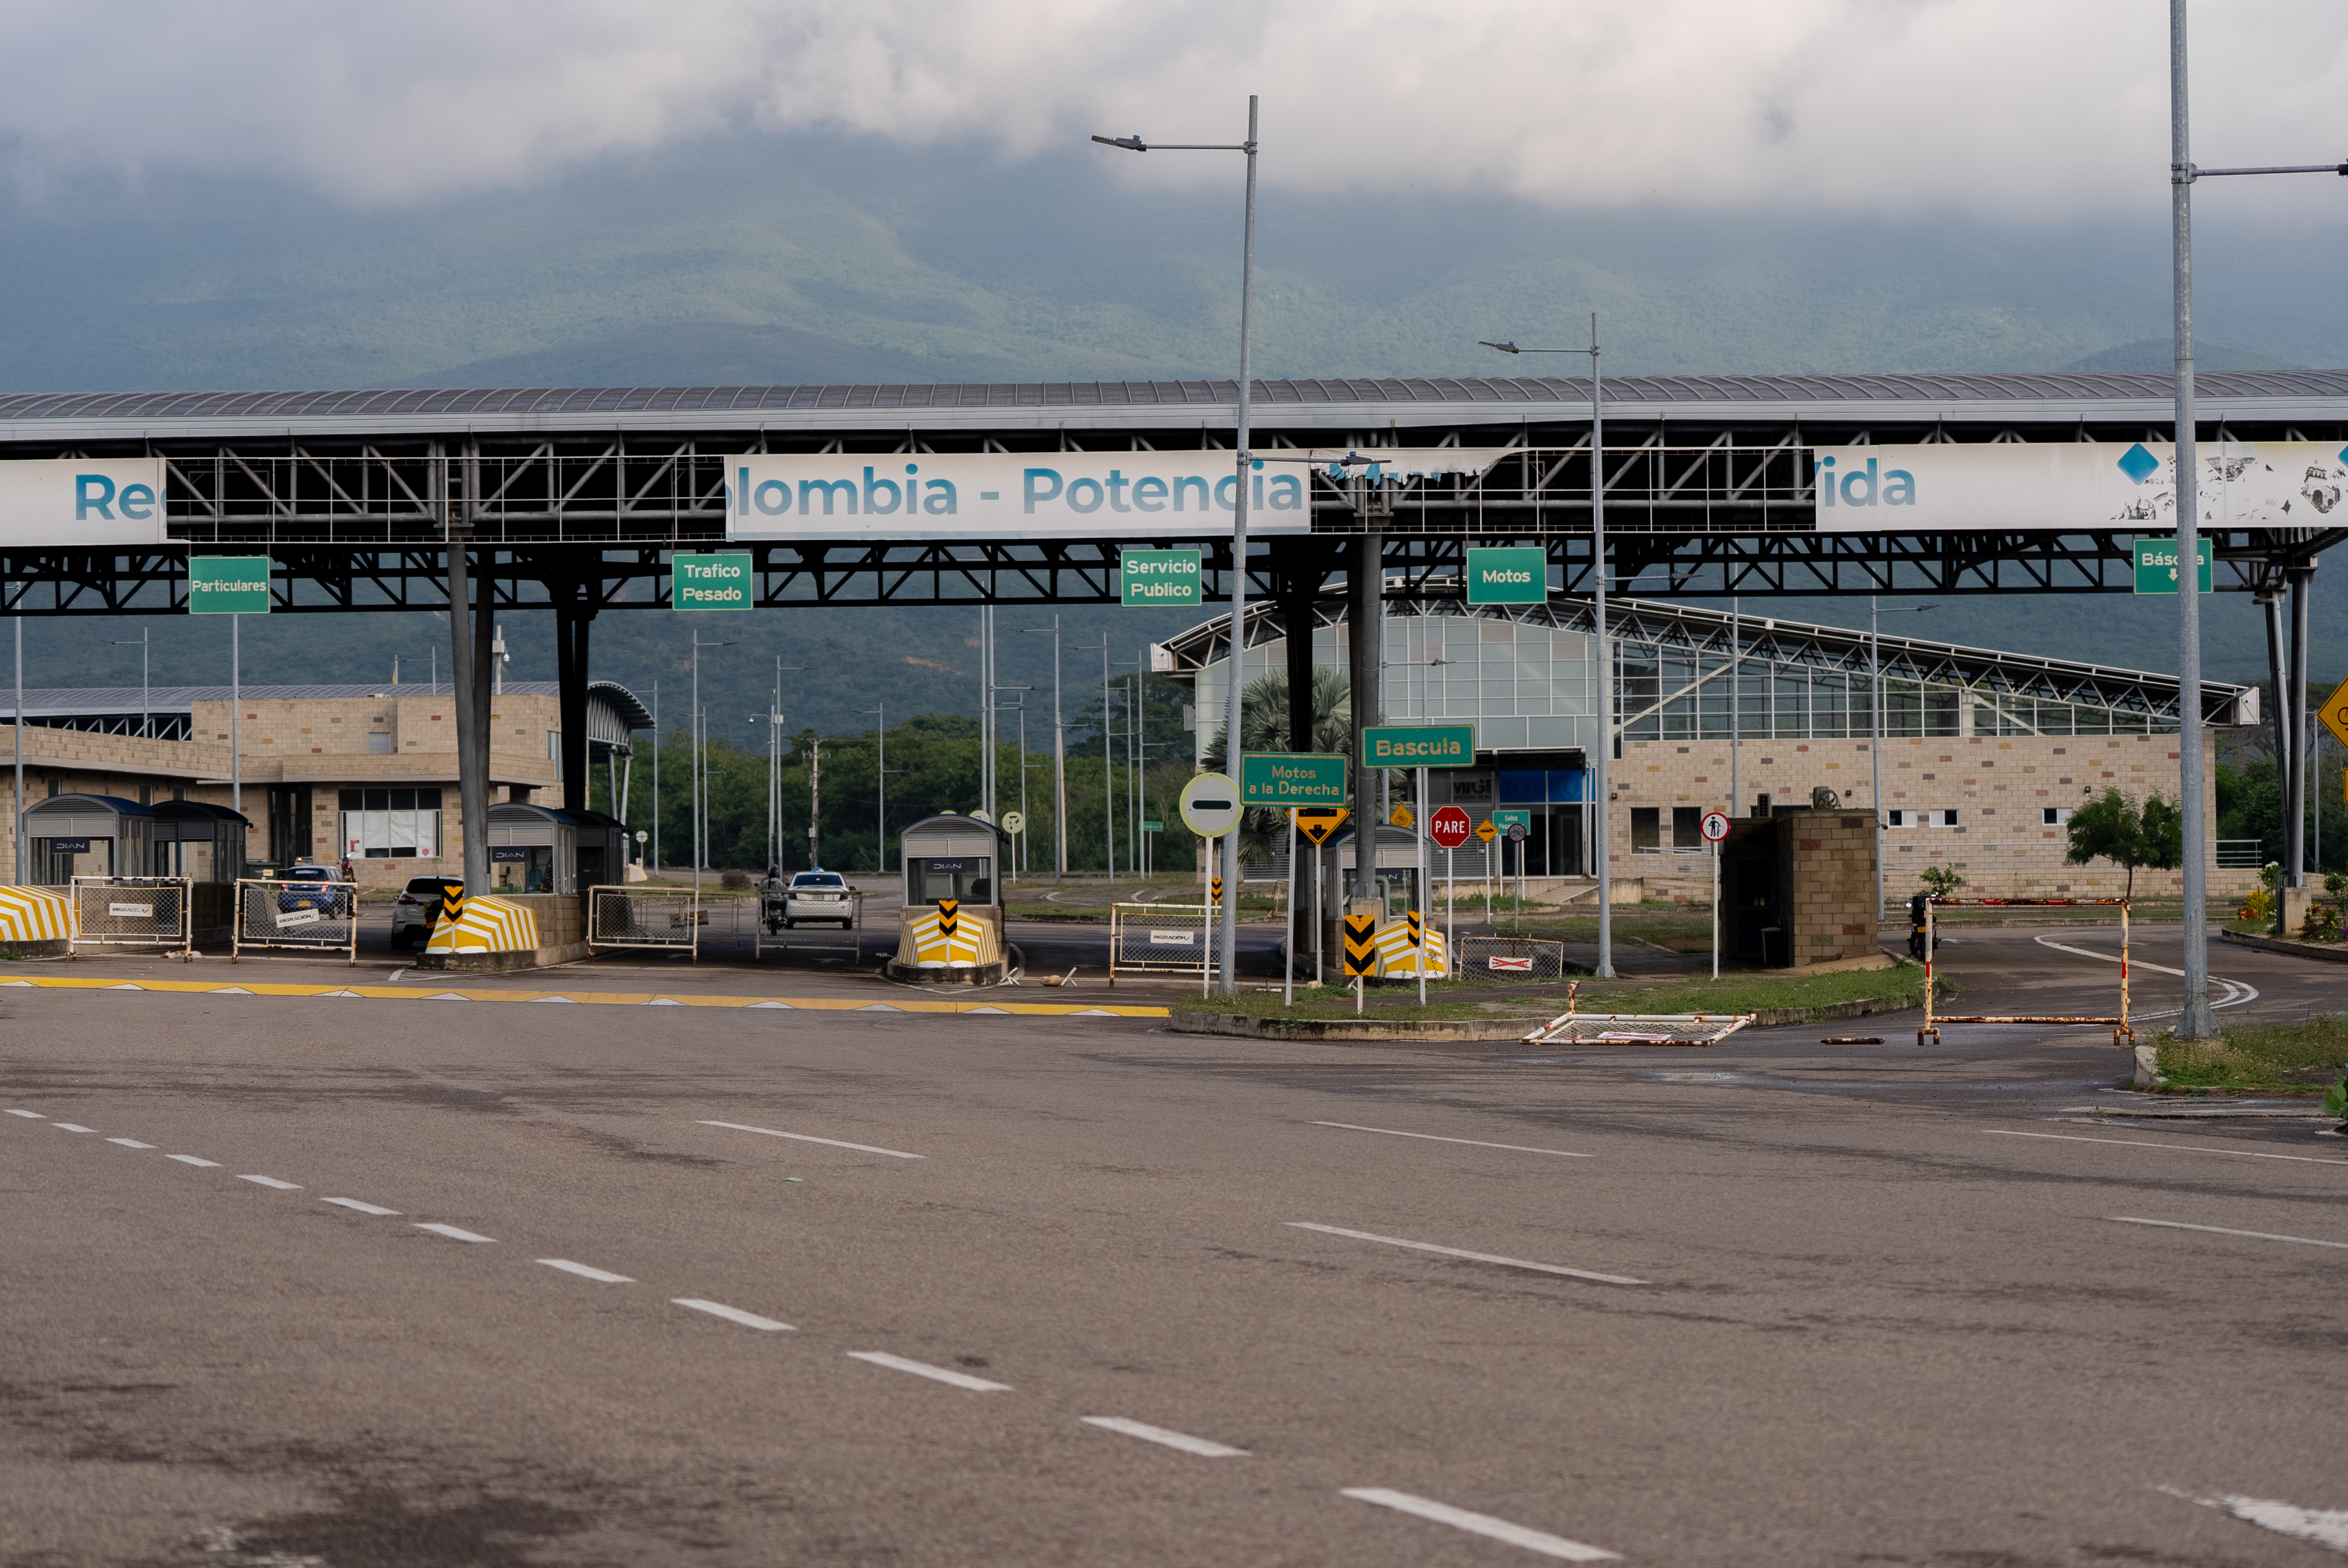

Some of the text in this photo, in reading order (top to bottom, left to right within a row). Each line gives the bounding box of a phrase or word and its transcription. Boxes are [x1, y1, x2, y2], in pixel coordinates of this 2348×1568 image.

[76, 474, 166, 528] Re
[1024, 461, 1302, 514] Potencia
[684, 564, 740, 578] Trafico
[1126, 559, 1197, 574] Servicio
[1482, 569, 1531, 583] Motos
[192, 579, 266, 592] Particulares
[1131, 582, 1192, 596] Publico
[683, 587, 742, 601] Pesado
[1272, 765, 1316, 778] Motos
[1249, 781, 1339, 796] a la Derecha
[1435, 821, 1465, 833] PARE
